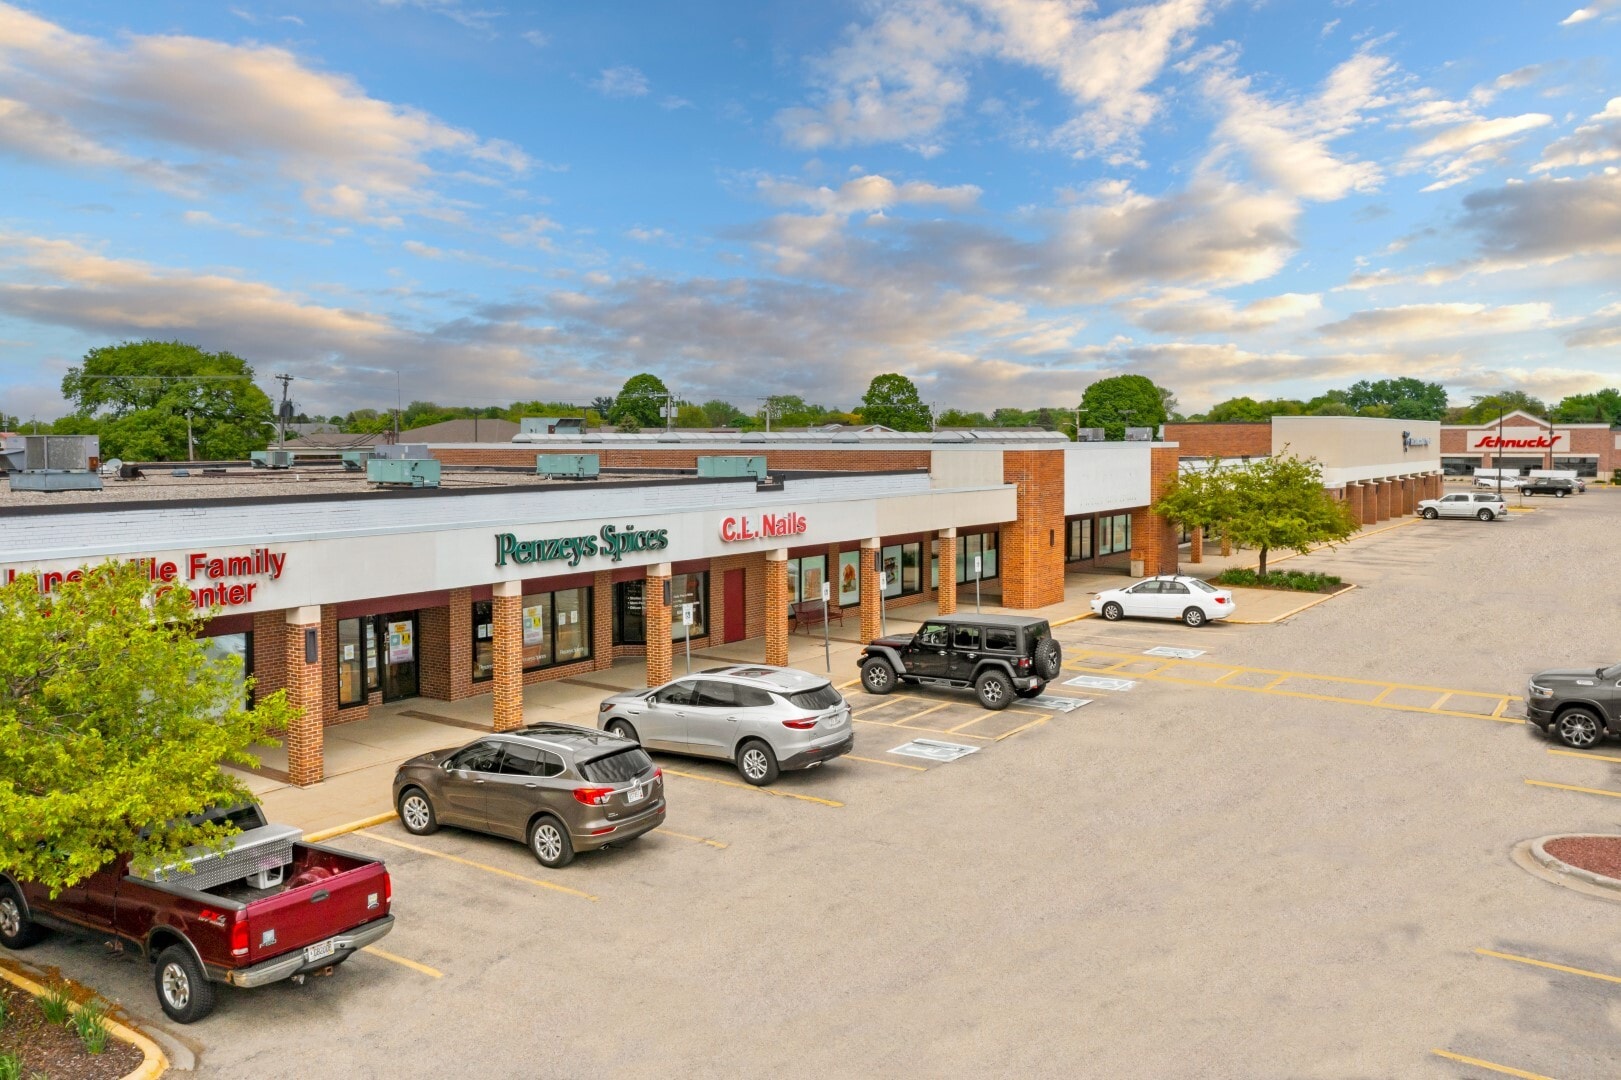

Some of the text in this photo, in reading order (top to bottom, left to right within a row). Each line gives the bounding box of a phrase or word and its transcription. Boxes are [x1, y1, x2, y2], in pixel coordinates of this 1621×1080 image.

[1474, 435, 1562, 448] Schnucks
[721, 511, 807, 541] C.L. Nails
[495, 524, 669, 568] Penzeys Spices
[188, 548, 287, 580] Family
